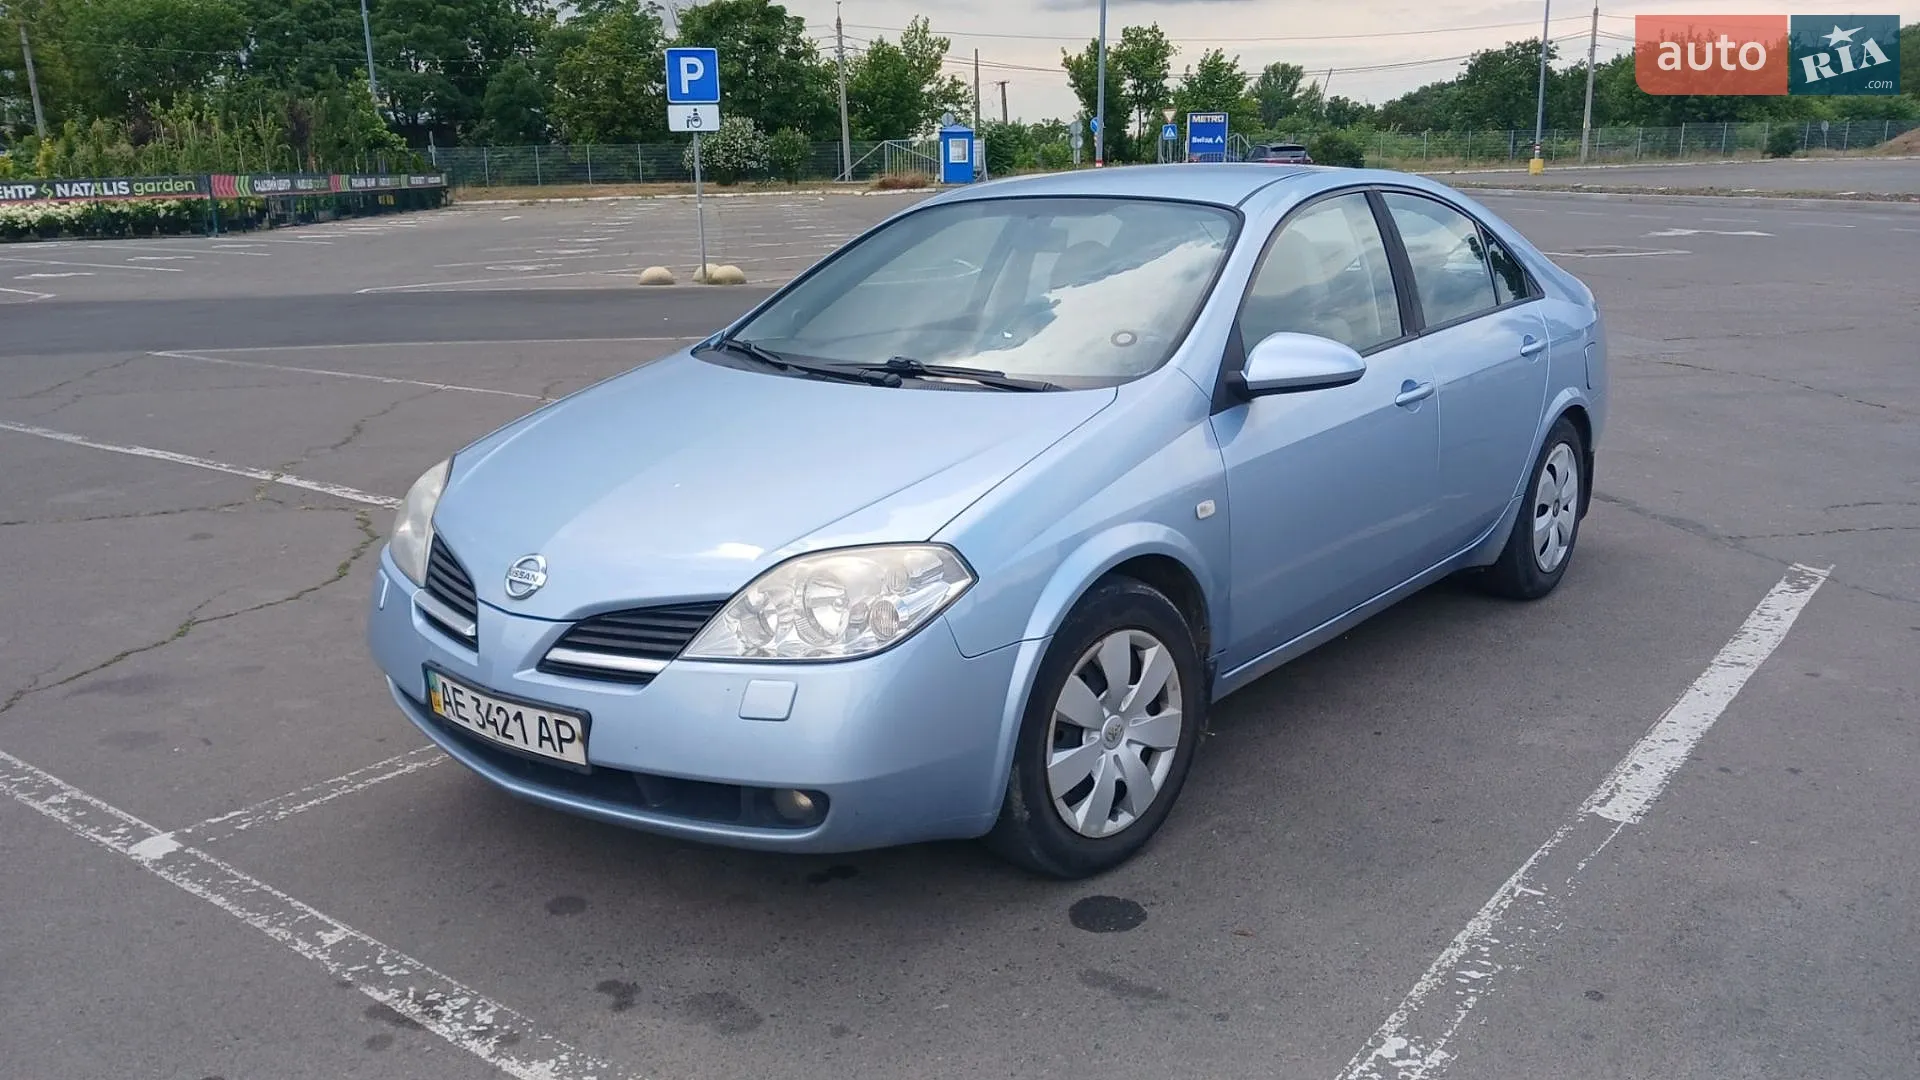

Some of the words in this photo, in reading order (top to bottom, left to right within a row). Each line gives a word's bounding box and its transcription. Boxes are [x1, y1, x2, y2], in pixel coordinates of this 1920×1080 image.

[680, 56, 704, 94] P
[1192, 115, 1224, 123] METRO
[55, 182, 130, 197] NATALIS
[133, 178, 196, 196] garden
[441, 681, 469, 724] AE
[470, 696, 528, 745] 3421
[537, 715, 576, 754] AP
